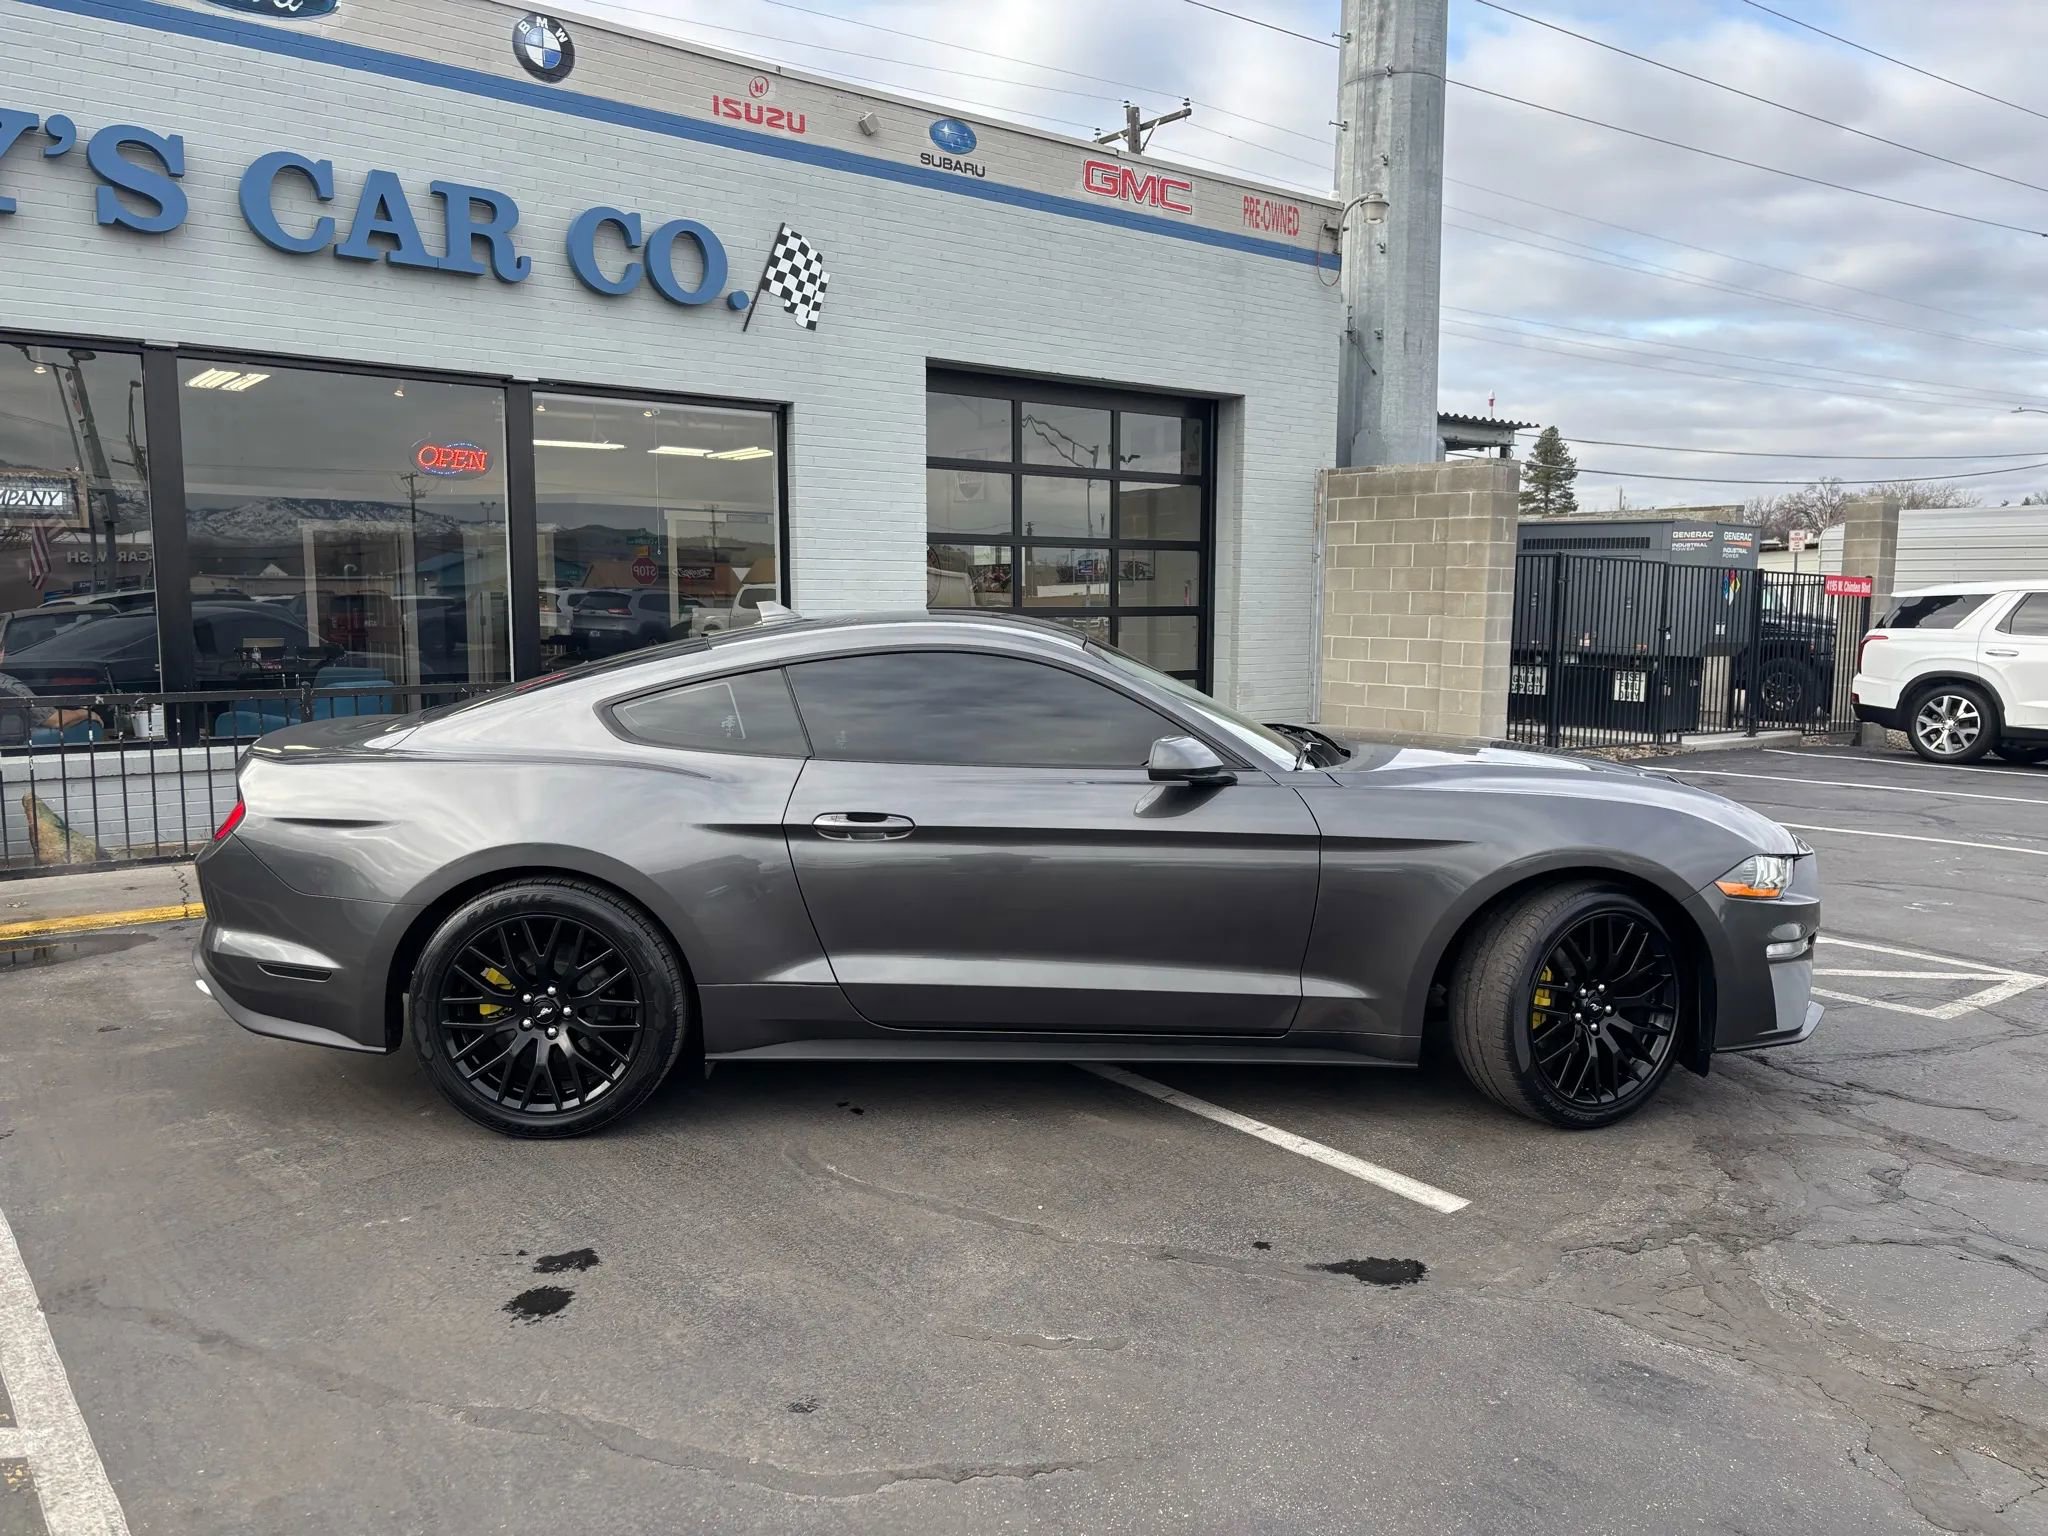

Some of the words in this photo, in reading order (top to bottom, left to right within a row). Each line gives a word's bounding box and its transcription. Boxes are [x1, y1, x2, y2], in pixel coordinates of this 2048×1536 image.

[518, 16, 569, 43] BMW
[712, 94, 806, 134] ISUZU
[920, 152, 986, 178] SUBARU
[1083, 159, 1193, 215] GMC
[239, 151, 532, 284] CAR
[566, 206, 750, 307] CO.
[1243, 195, 1300, 236] PRE-OWNED
[417, 445, 489, 472] OPEN
[1672, 531, 1714, 539] GENERAC
[1723, 531, 1753, 541] GENERAC
[1619, 690, 1640, 699] ONY
